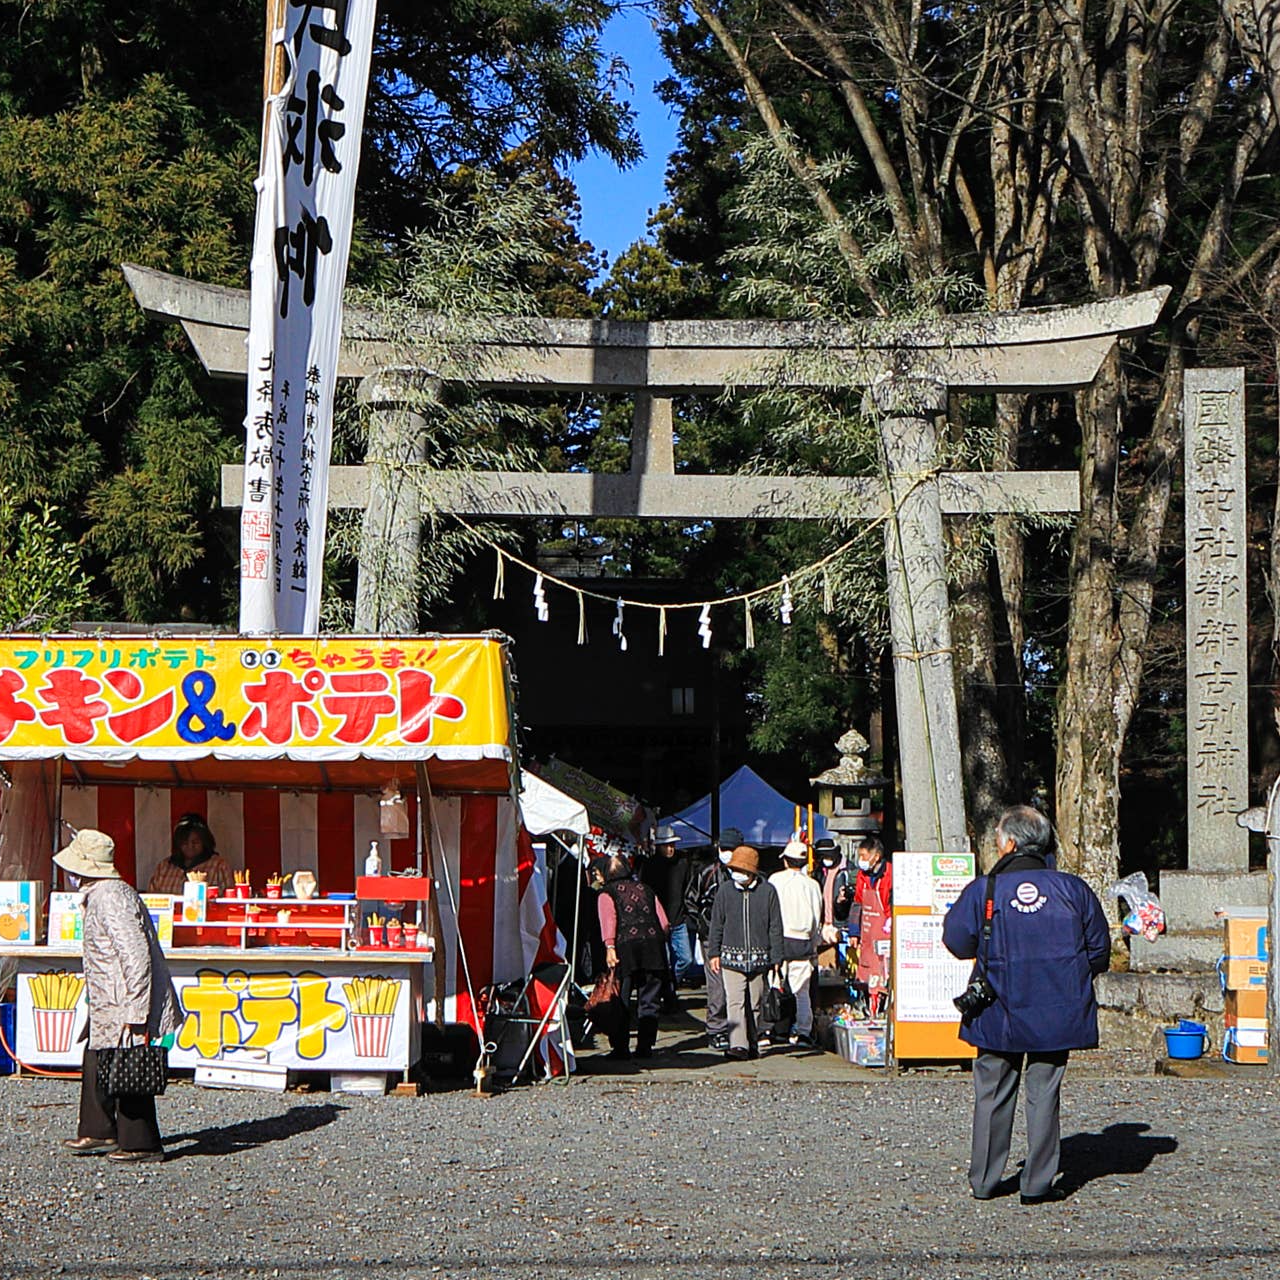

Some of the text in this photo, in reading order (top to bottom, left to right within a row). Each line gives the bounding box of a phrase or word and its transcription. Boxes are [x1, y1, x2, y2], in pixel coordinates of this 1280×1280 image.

[14, 648, 216, 669] フリフリポテト
[177, 968, 347, 1060] ポテト
